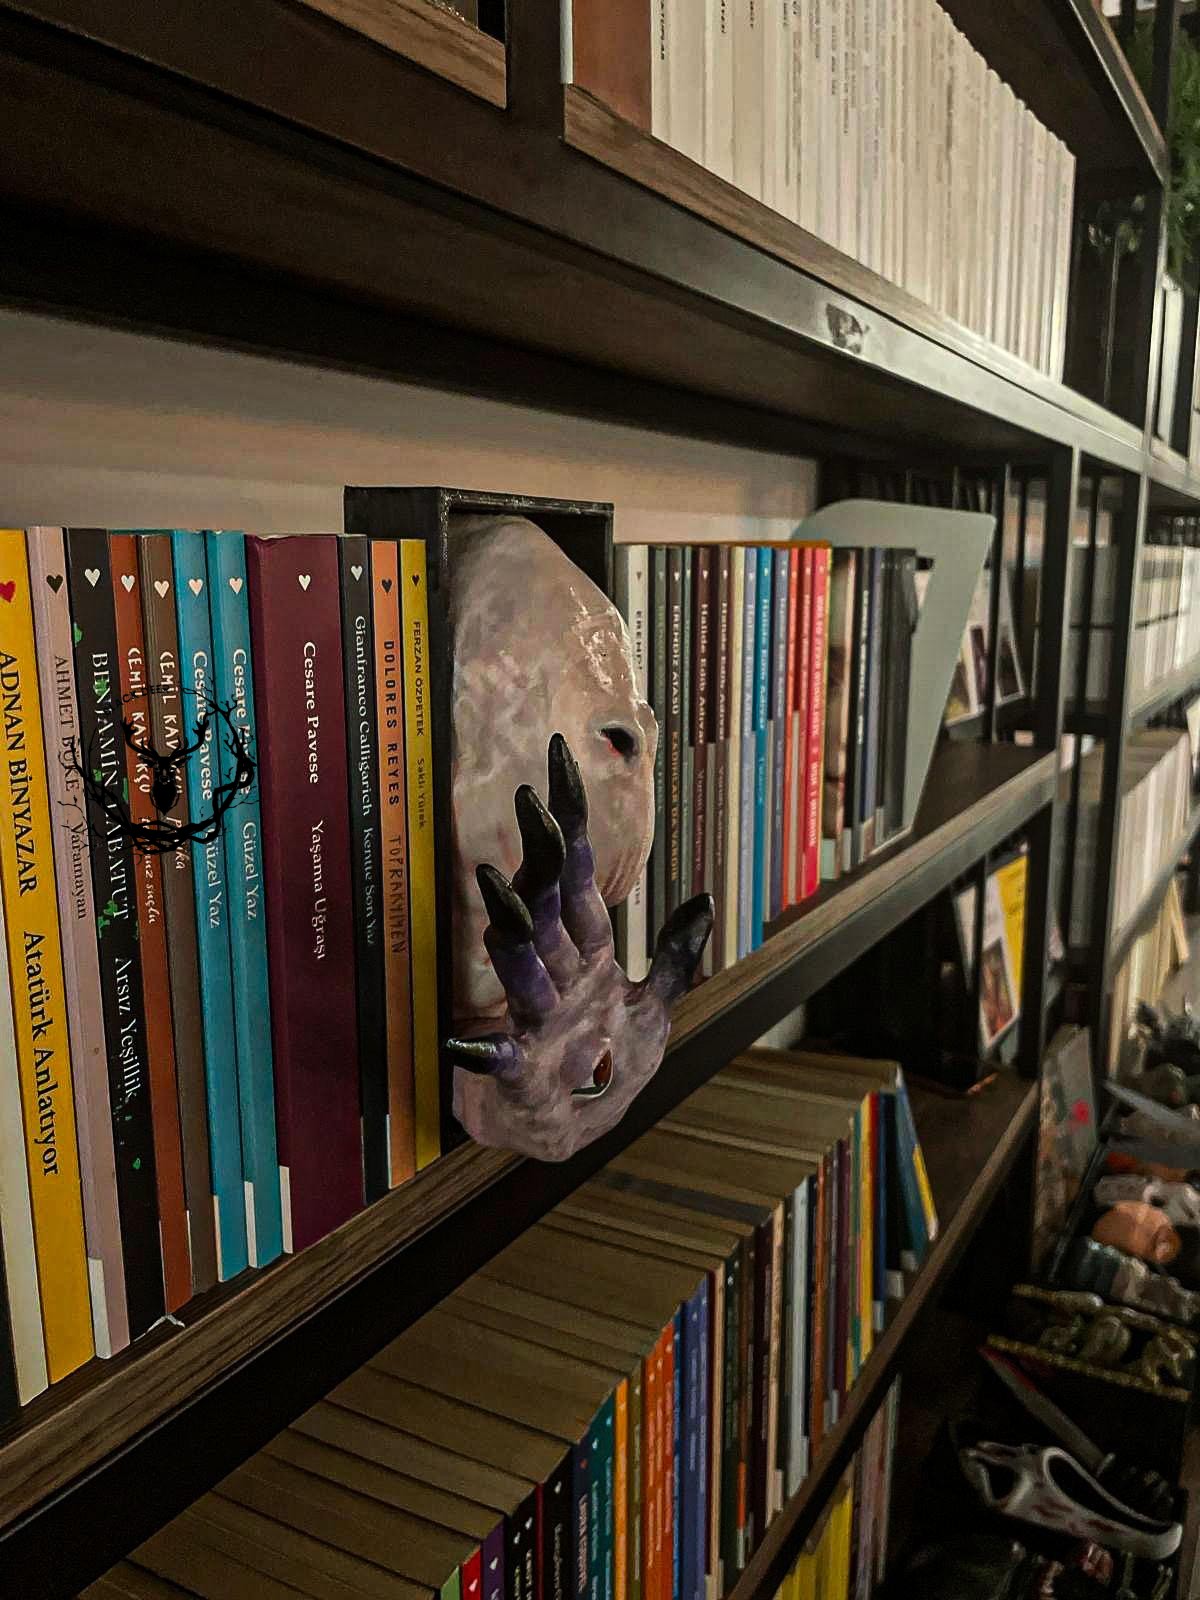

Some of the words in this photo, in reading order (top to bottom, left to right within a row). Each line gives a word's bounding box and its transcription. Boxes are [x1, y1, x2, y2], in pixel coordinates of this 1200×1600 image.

[412, 621, 422, 674] FERZAN
[634, 610, 644, 670] EREND
[700, 603, 709, 654] Halide
[0, 652, 26, 751] ADNAN
[54, 655, 74, 729] AHMET
[159, 650, 179, 704] CEMİL
[192, 650, 210, 721] Cesare
[232, 648, 249, 719] Cesare
[302, 640, 318, 710] Cesare
[354, 615, 368, 718] Gianfranco
[382, 640, 398, 730] DOLORES
[699, 658, 707, 692] Edib
[415, 677, 425, 738] ÖZPETEK
[698, 695, 707, 745] Adıvar
[60, 736, 80, 792] BÜKE
[132, 711, 151, 794] KAVKÇU
[198, 728, 214, 801] Pavese
[305, 713, 319, 785] Pavese
[356, 719, 372, 818] Calligarich
[385, 743, 401, 807] REYES
[8, 757, 38, 897] BİNYAZAR
[241, 821, 259, 882] Güzel
[307, 819, 324, 894] Yaşama
[69, 822, 88, 920] Varamayan
[145, 883, 160, 925] suçlu
[245, 886, 260, 921] Yaz
[364, 884, 376, 918] Son
[209, 893, 223, 929] Yaz
[310, 896, 326, 961] Uğraşı
[23, 930, 54, 1041] Atatürk
[115, 957, 134, 1016] Arsız
[119, 1018, 144, 1100] Yeşillik
[33, 1047, 59, 1177] Anlatıyor
